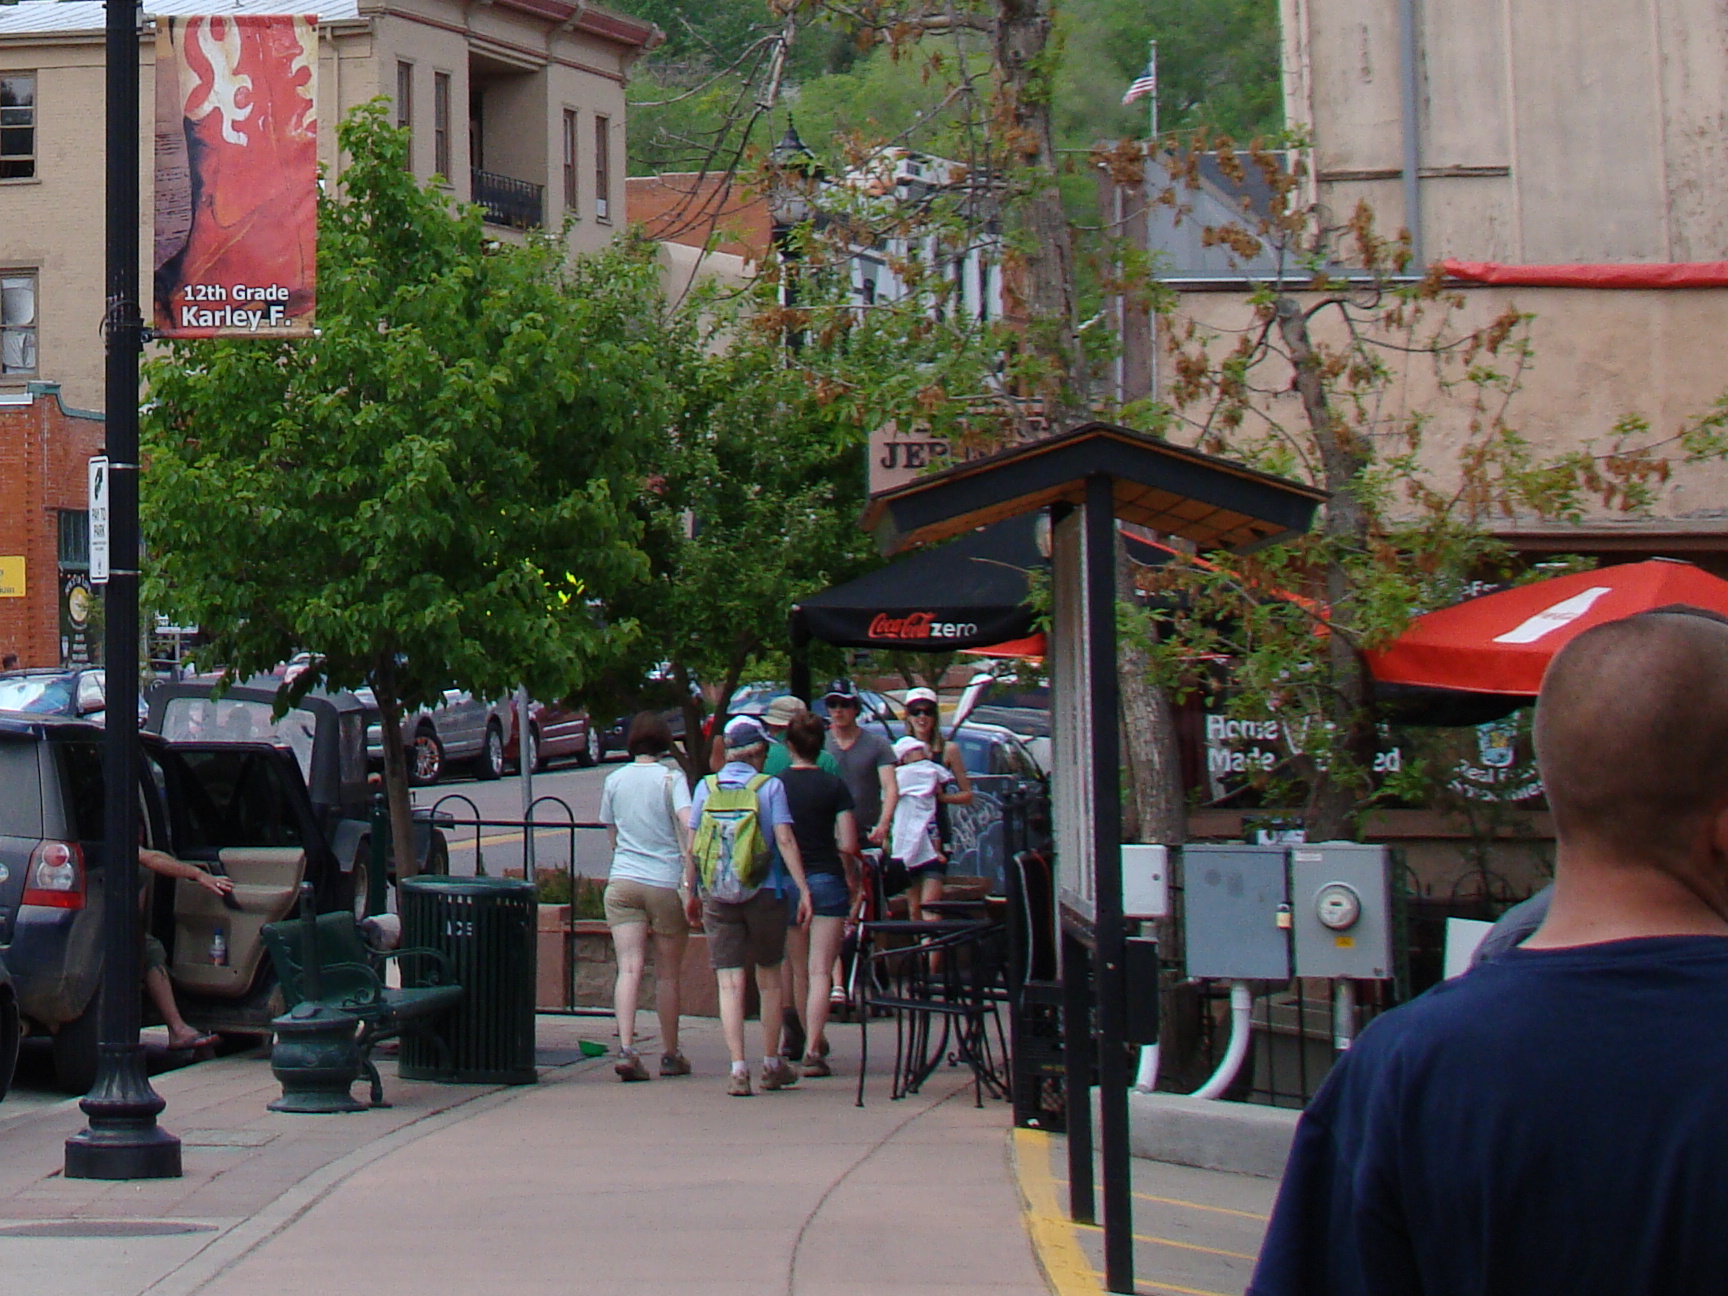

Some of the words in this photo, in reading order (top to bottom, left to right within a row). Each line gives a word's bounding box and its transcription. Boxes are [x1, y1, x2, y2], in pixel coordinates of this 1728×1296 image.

[184, 284, 227, 301] 12th
[232, 284, 289, 301] Grade
[182, 305, 262, 331] Karley
[270, 305, 291, 326] F.
[931, 622, 977, 638] zero
[1208, 747, 1277, 773] Made
